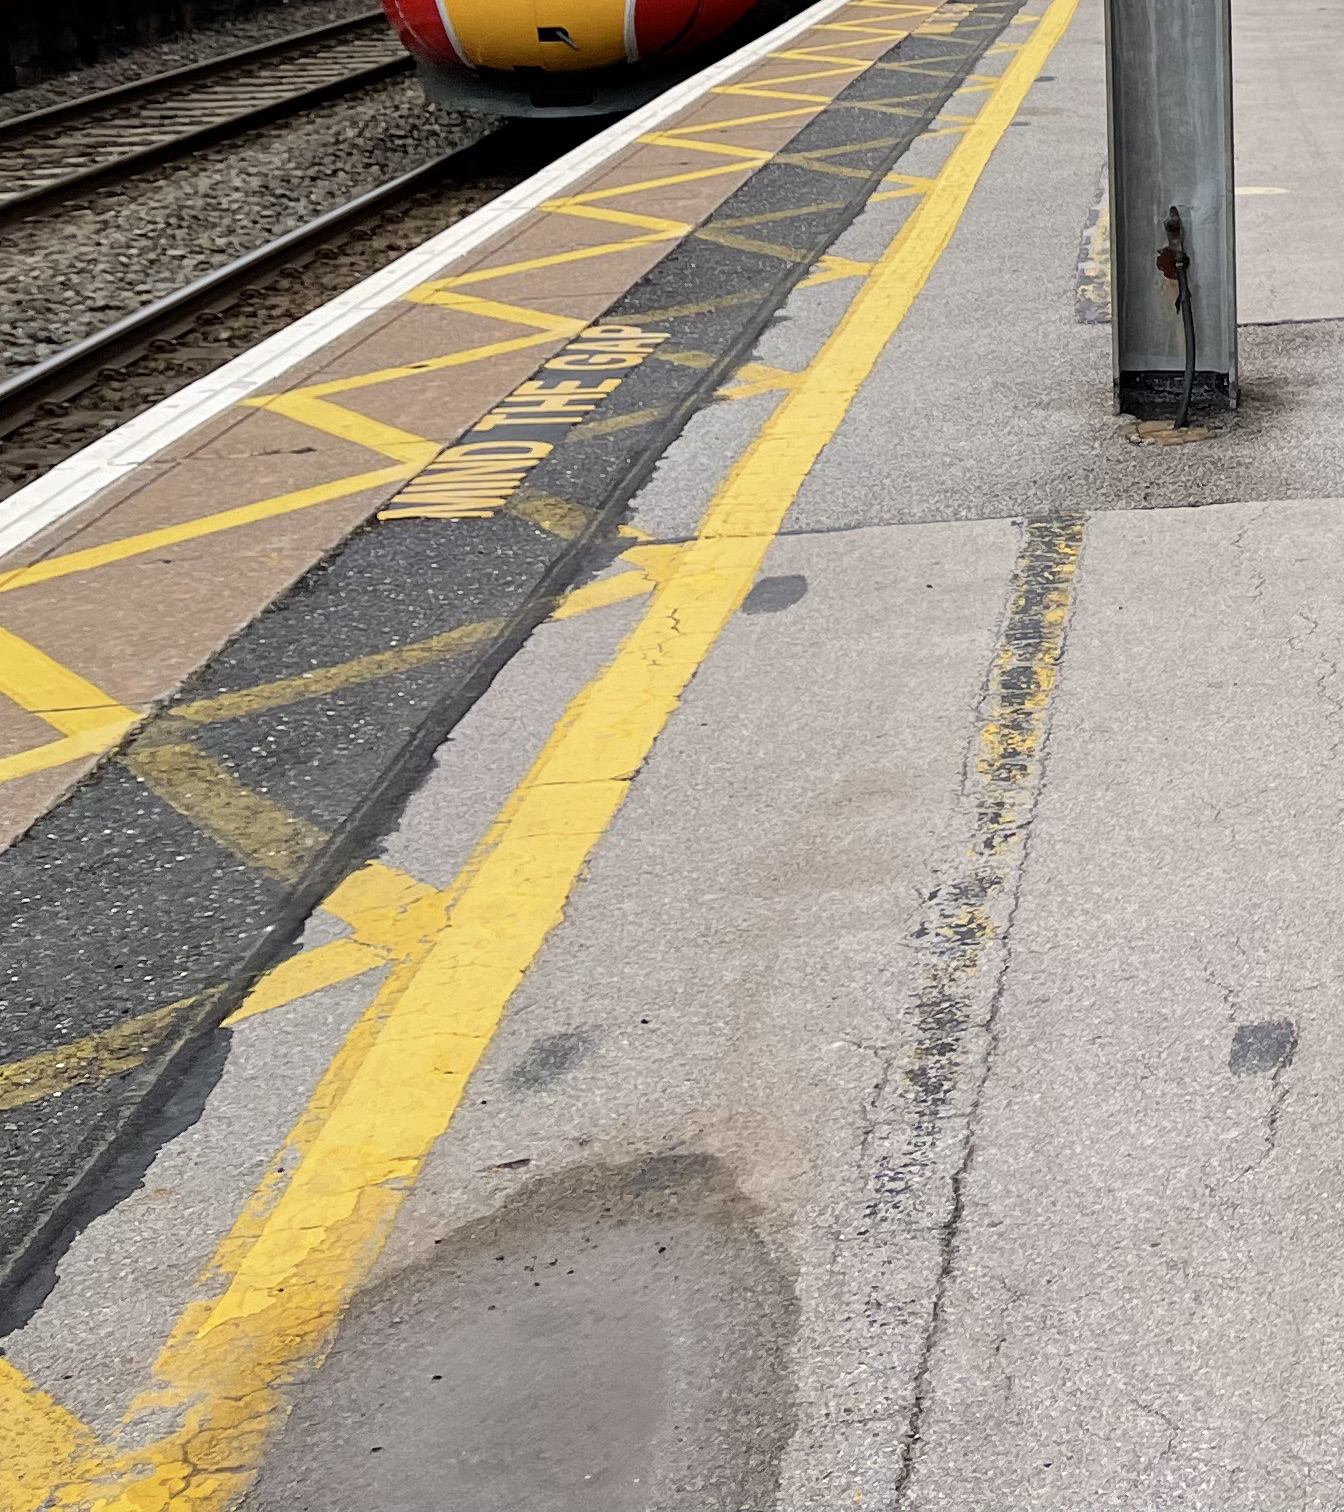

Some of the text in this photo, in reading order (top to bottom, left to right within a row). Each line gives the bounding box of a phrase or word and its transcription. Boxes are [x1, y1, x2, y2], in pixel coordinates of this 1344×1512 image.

[376, 324, 671, 521] MIND THE GAP
